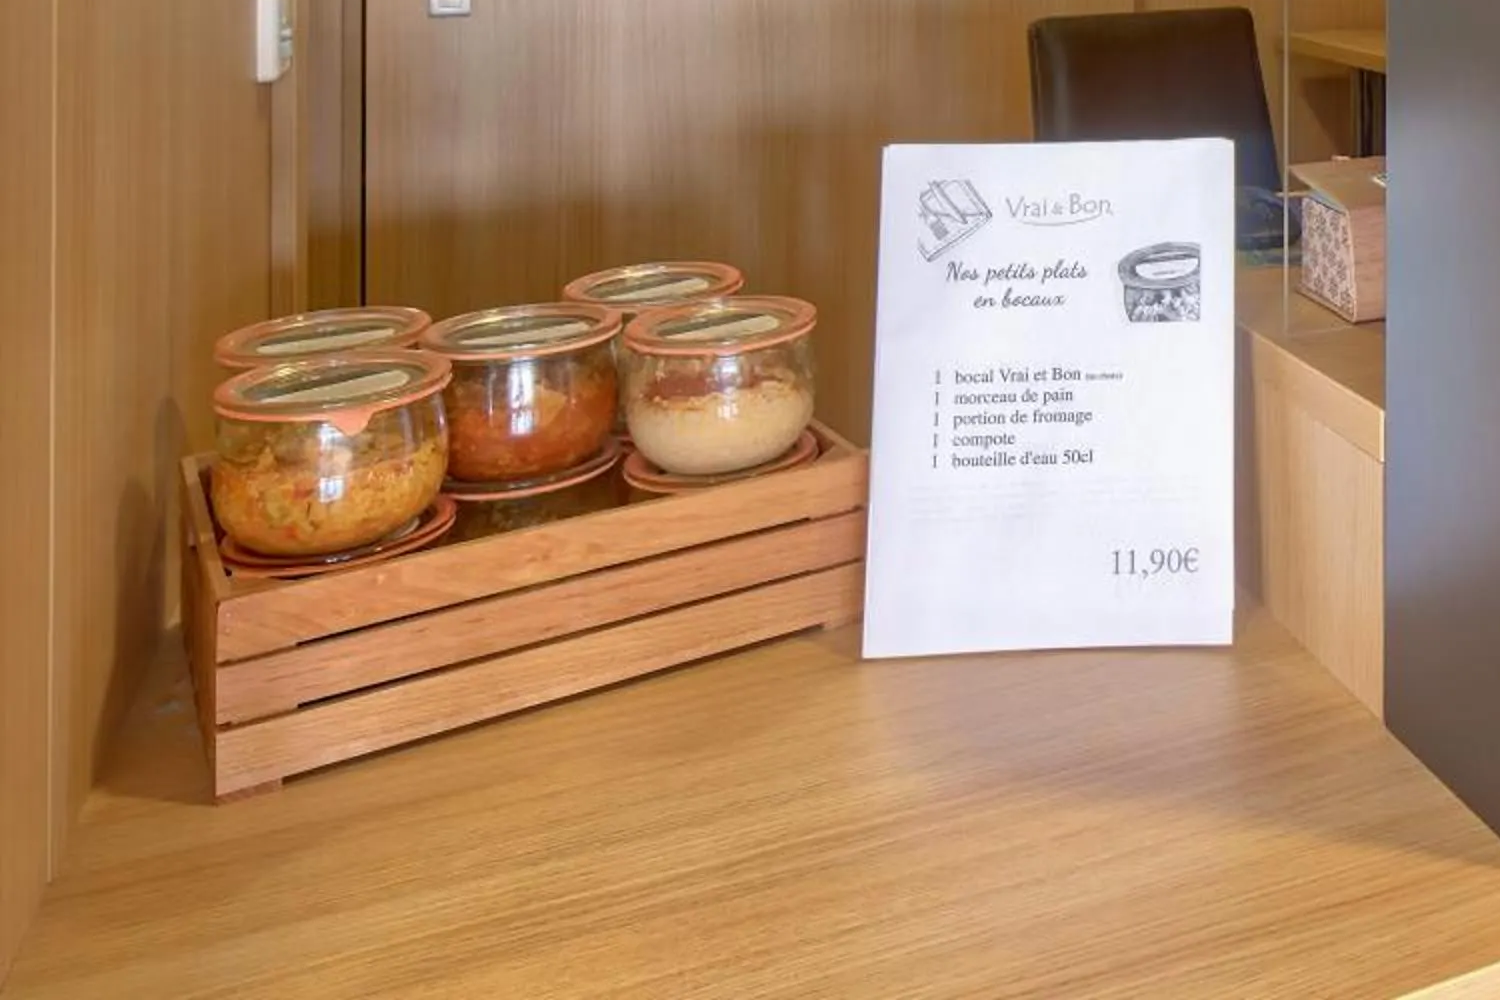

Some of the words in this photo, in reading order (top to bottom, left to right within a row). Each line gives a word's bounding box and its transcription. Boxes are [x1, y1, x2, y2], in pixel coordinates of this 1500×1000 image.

[1005, 197, 1047, 218] Vrai
[1068, 193, 1114, 217] Bon
[945, 262, 979, 283] Nos
[984, 261, 1036, 285] petits
[1040, 259, 1087, 286] plats
[973, 294, 996, 308] en
[1001, 287, 1066, 308] bocaux
[955, 368, 994, 383] bocal
[998, 368, 1029, 383] Vrai
[1034, 371, 1048, 382] et
[1051, 367, 1081, 382] Bon
[954, 392, 1017, 405] morceau
[1021, 389, 1039, 404] de
[1043, 389, 1074, 408] pain
[953, 411, 1006, 430] portion
[1010, 410, 1028, 425] de
[1032, 409, 1093, 426] fromage
[952, 432, 1015, 449] compote
[951, 452, 1016, 468] bouteille
[1020, 451, 1058, 466] d'eau
[1062, 449, 1094, 465] 50cl
[1111, 548, 1200, 579] 11,90€
